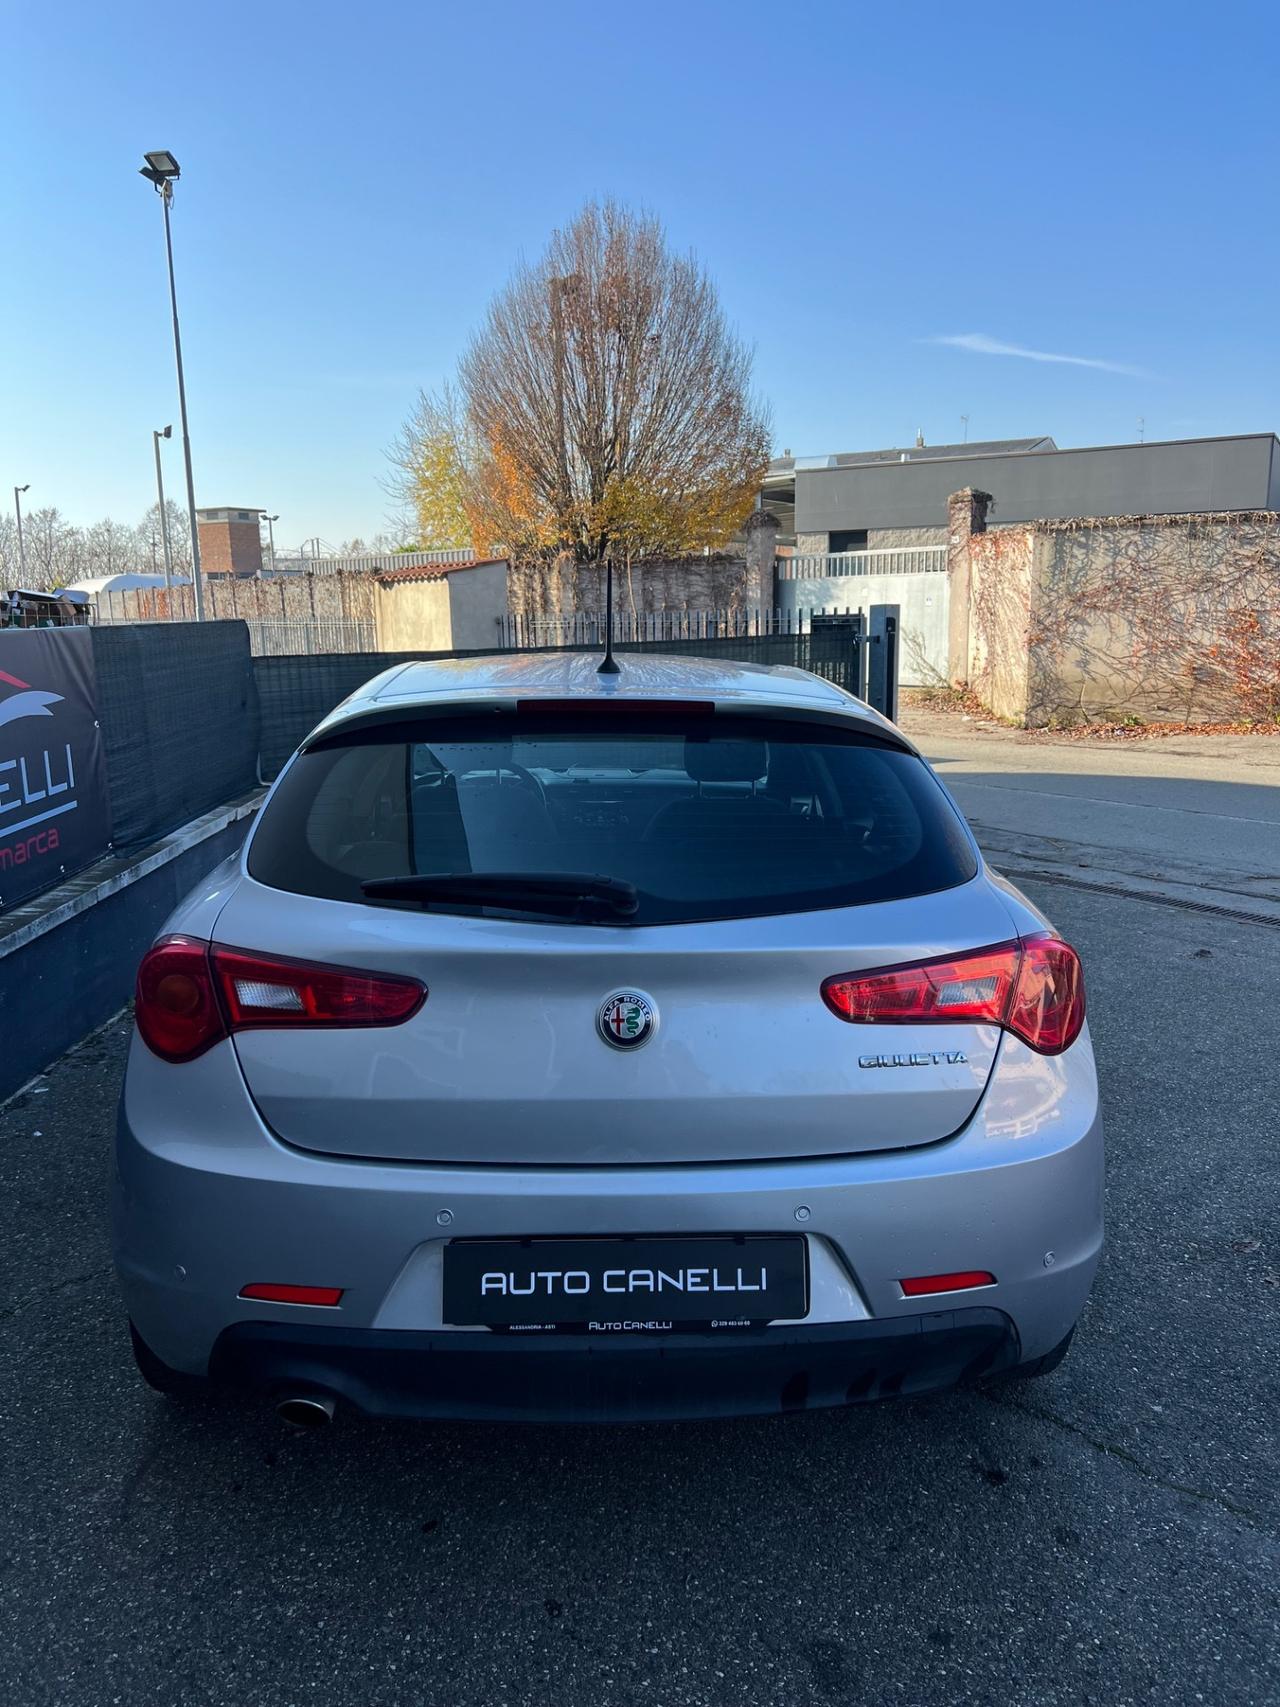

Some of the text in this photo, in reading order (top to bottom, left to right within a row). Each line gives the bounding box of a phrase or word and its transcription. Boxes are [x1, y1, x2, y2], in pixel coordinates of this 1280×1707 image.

[858, 1051, 968, 1069] GIULIETTA
[481, 1267, 767, 1295] AUTO CANELLI
[623, 1321, 672, 1329] CANELLI
